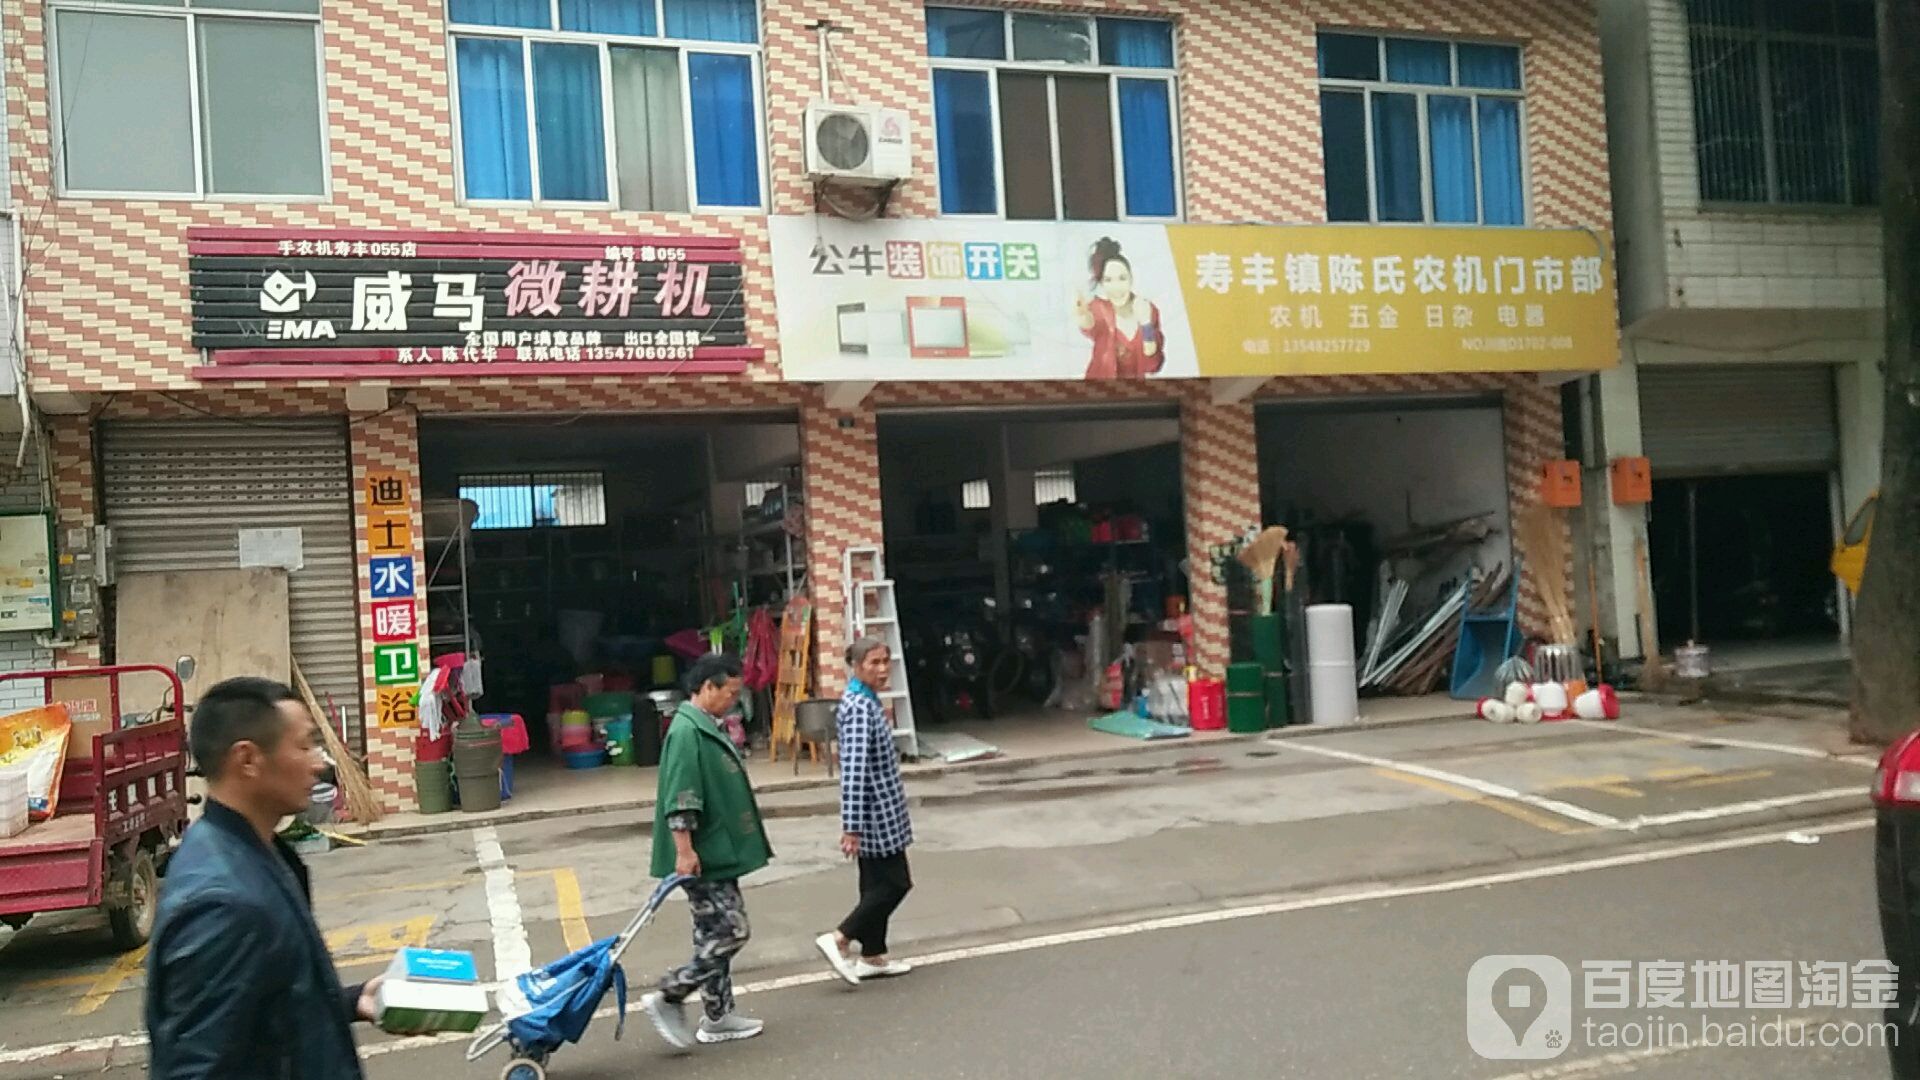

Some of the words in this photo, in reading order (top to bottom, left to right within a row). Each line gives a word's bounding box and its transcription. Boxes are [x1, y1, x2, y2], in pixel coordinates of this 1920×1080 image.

[809, 241, 1039, 280] 公牛装饰开关
[1197, 254, 1602, 294] 寿丰镇陈氏农机门市部
[350, 269, 484, 331] 威马
[504, 260, 712, 317] 微耕机
[1269, 304, 1323, 329] 农机
[1348, 304, 1400, 329] 五金
[1426, 304, 1473, 328] 日杂
[441, 346, 498, 363] 陈代华
[516, 345, 581, 362] 联系电话
